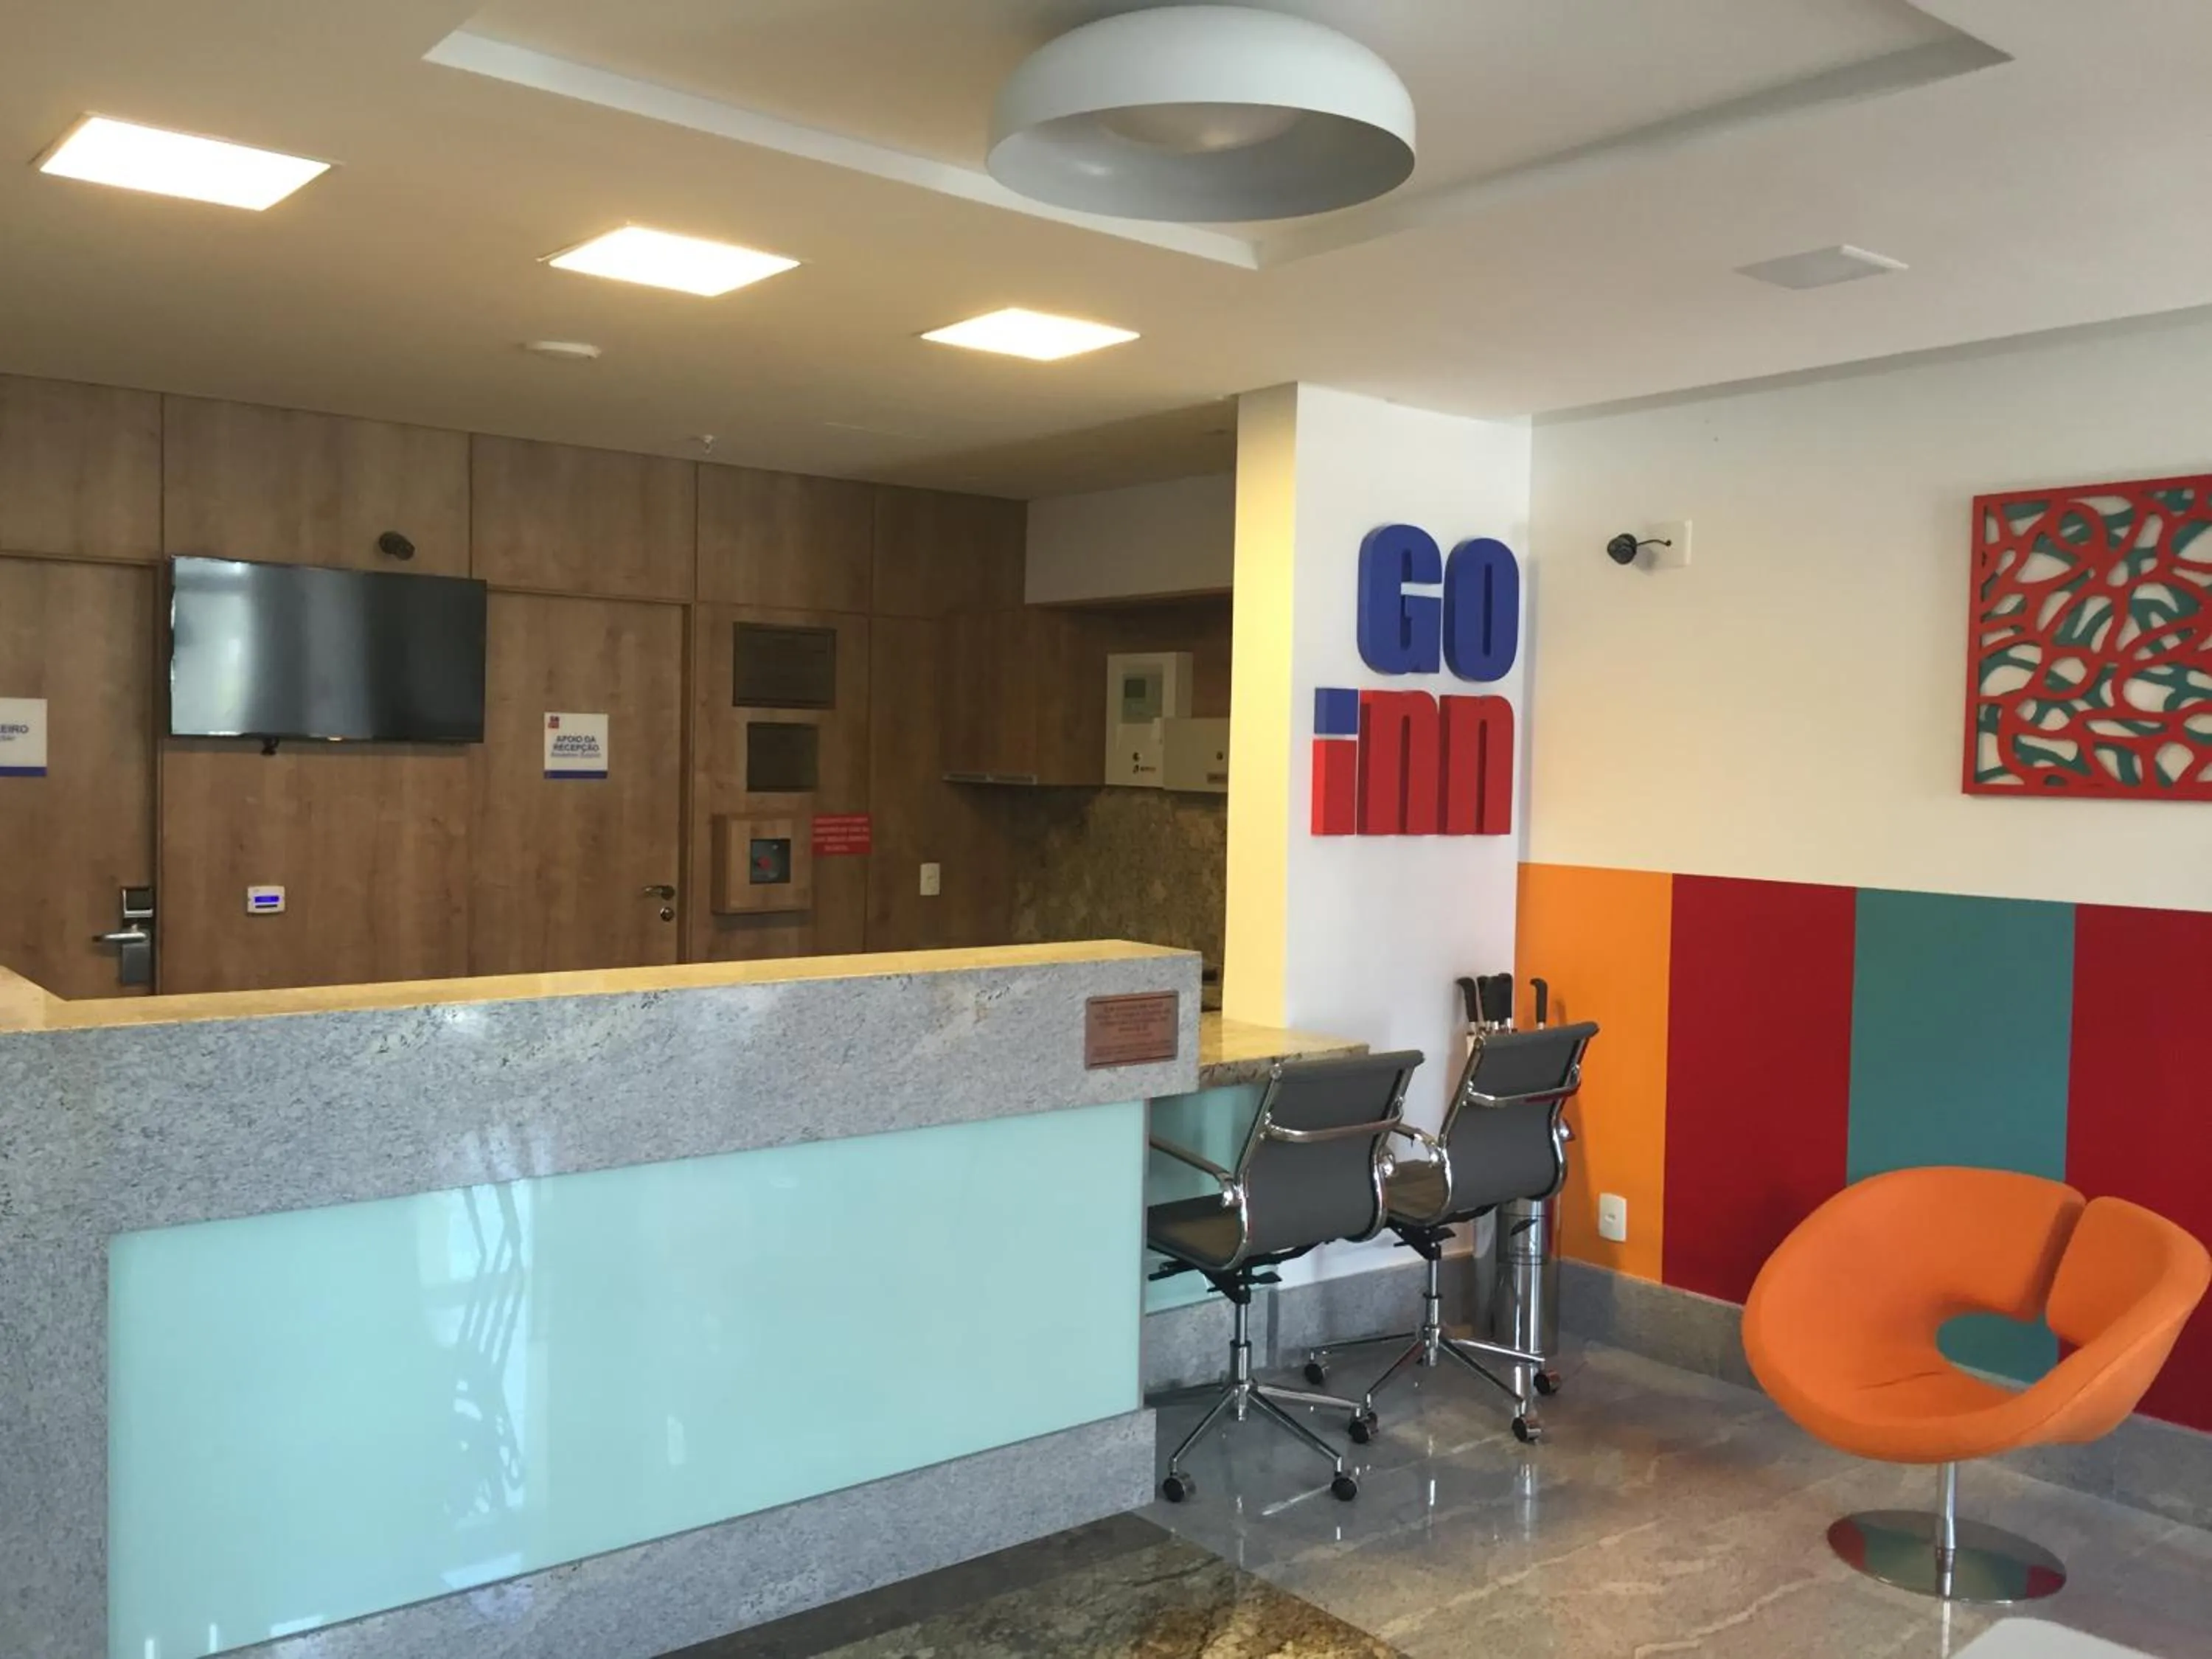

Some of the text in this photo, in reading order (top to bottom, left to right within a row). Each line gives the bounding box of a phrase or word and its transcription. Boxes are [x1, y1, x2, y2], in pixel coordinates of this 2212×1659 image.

[1357, 524, 1519, 683] GO
[0, 724, 29, 734] EIRO
[1311, 687, 1514, 836] inn
